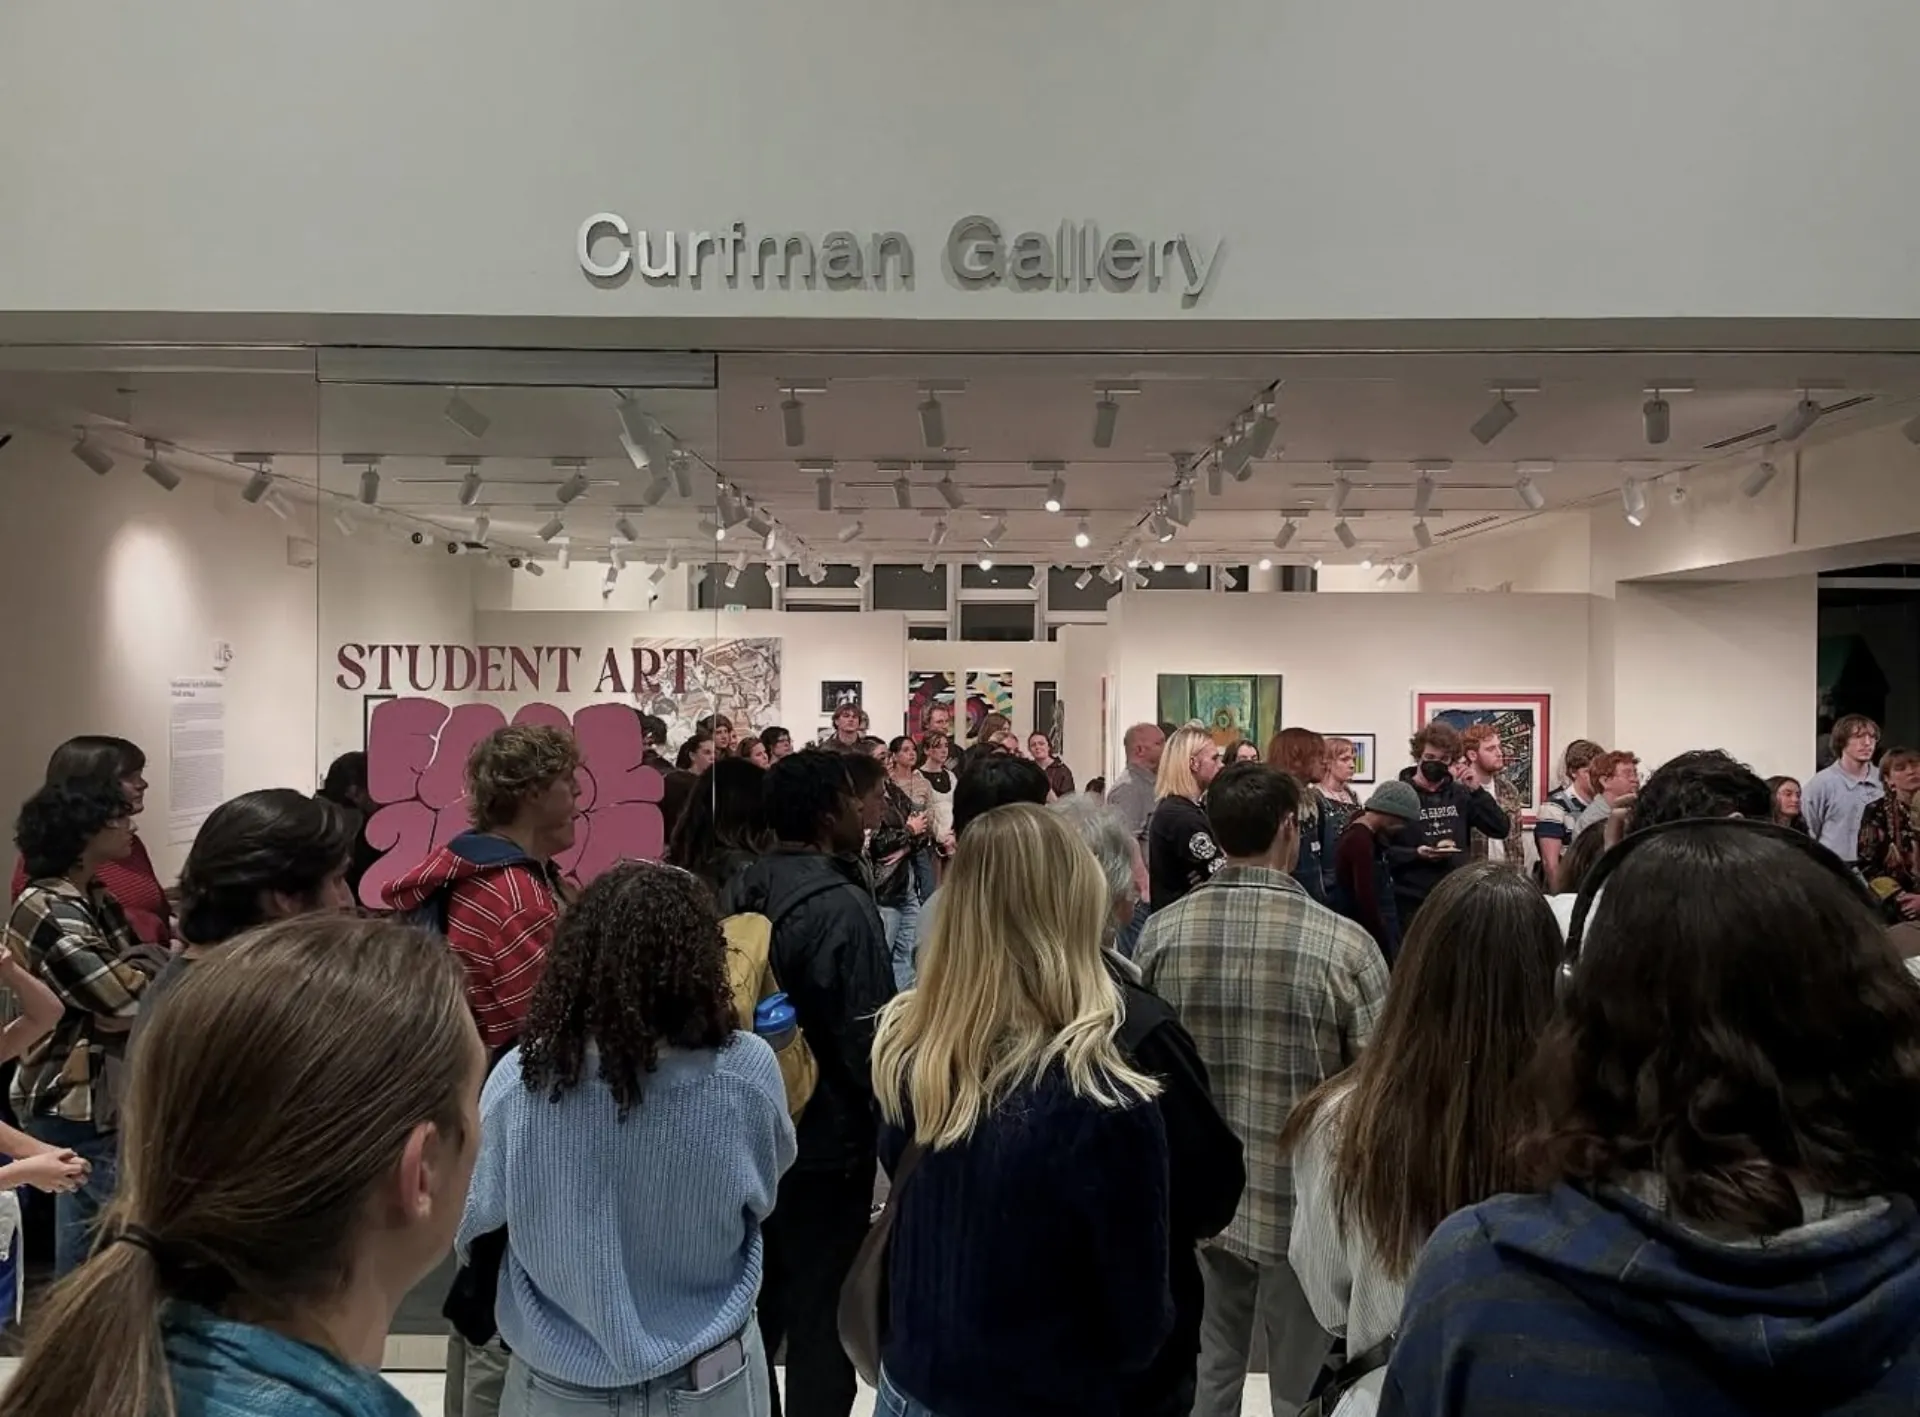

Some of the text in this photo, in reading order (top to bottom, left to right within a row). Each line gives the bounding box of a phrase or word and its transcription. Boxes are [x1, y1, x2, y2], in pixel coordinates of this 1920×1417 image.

[576, 212, 1223, 298] Curfman Gallery
[336, 643, 699, 694] STUDENT ART
